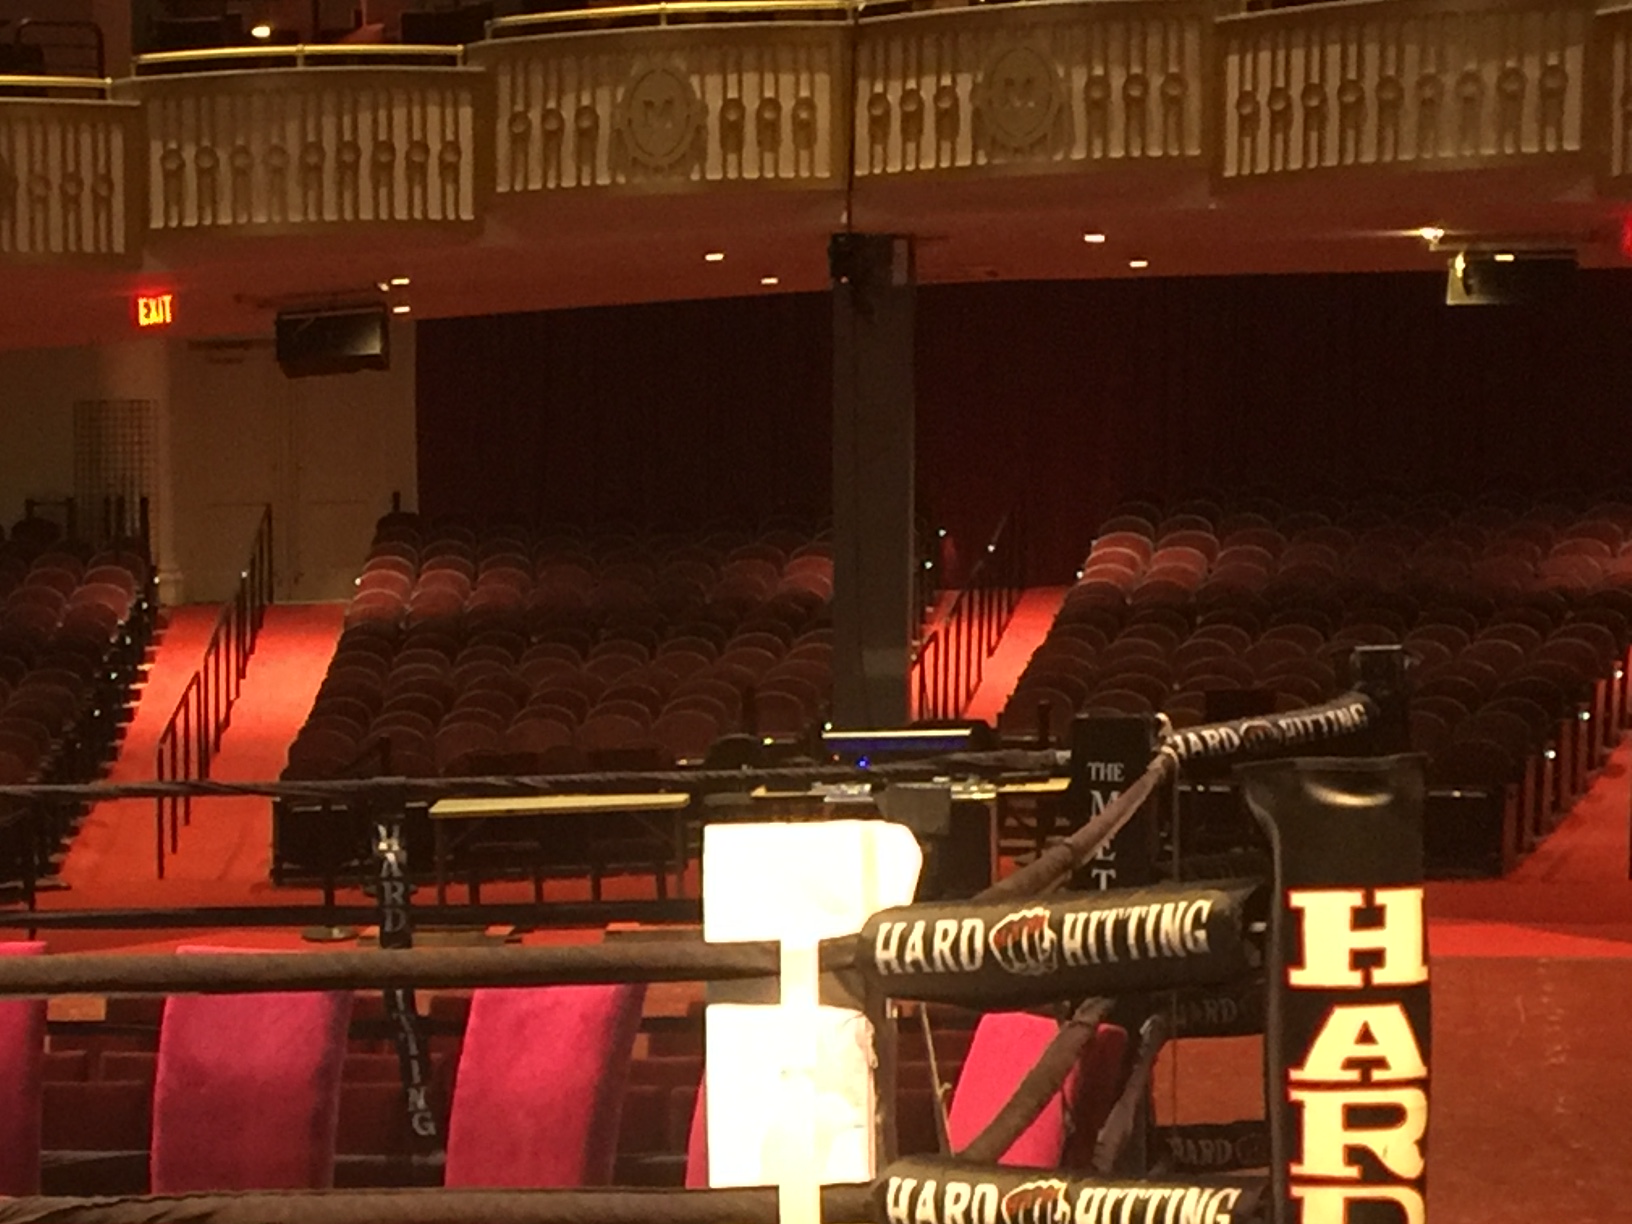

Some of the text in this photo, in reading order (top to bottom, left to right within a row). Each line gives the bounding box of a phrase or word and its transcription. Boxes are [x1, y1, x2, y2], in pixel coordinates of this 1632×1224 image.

[137, 294, 172, 326] EXIT
[1086, 761, 1125, 781] THE
[376, 823, 406, 933] HARD
[874, 917, 985, 977] HARD
[1061, 898, 1215, 968] HITTING
